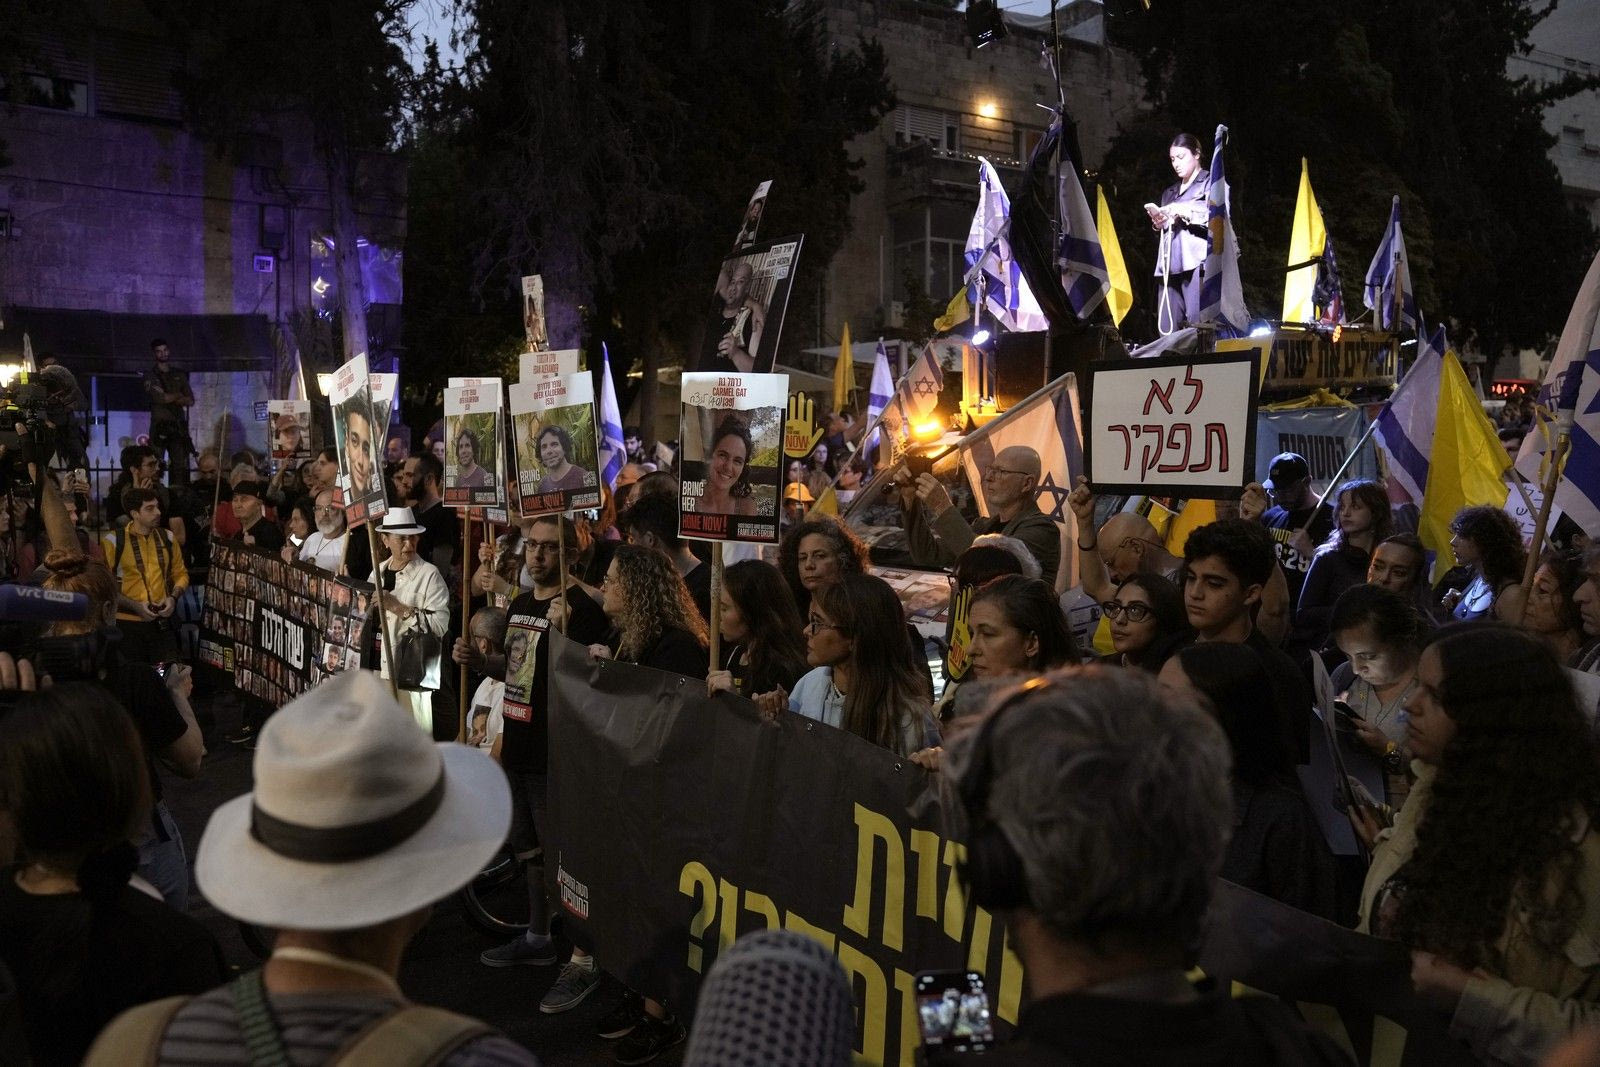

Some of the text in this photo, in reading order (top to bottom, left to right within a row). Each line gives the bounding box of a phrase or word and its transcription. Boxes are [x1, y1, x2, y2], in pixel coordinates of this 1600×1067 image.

[712, 387, 748, 397] CARMEL GAT
[1143, 364, 1203, 415] לא
[785, 435, 809, 448] NOW
[1108, 423, 1229, 482] תפקיר
[520, 469, 540, 484] BRING
[521, 482, 535, 497] HIM
[682, 480, 704, 497] BRING
[682, 496, 695, 512] HER
[682, 514, 727, 532] HOME NOW!
[737, 528, 775, 538] FAMILIES FORUM
[15, 587, 42, 599] vrt
